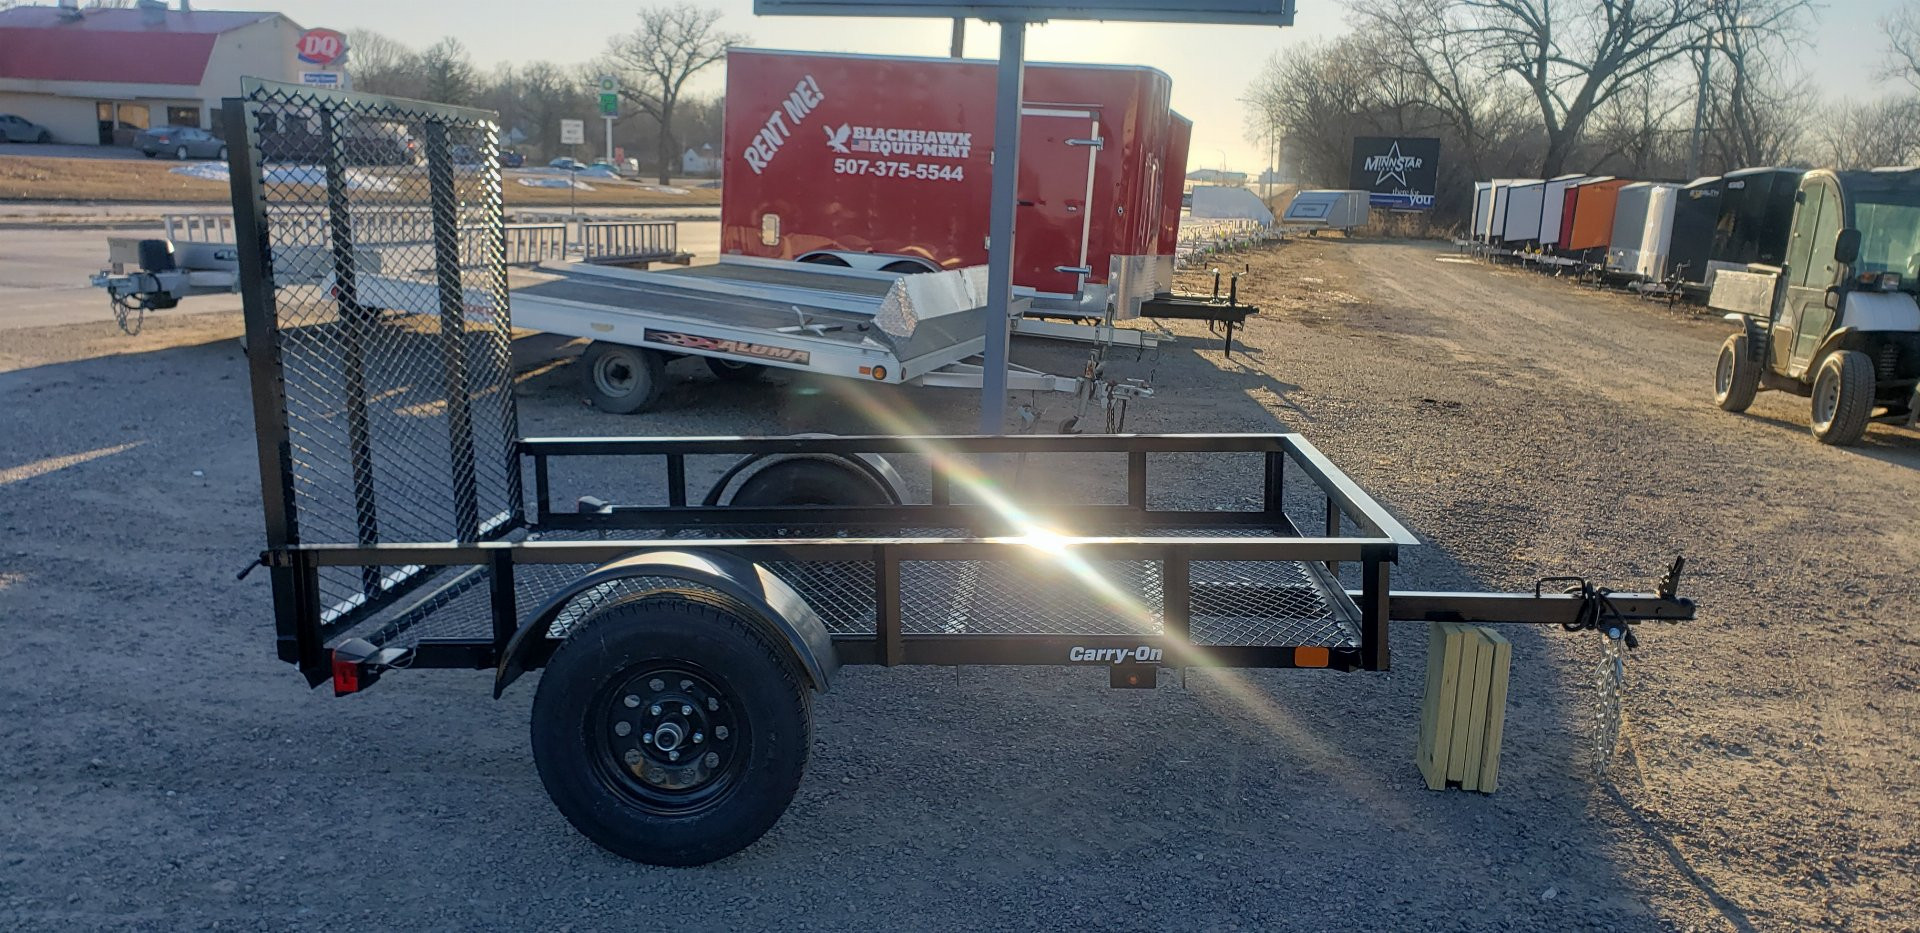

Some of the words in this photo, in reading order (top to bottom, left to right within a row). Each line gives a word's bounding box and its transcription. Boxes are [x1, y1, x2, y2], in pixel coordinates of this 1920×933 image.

[305, 36, 338, 58] DQ
[744, 111, 790, 175] RENT
[783, 74, 825, 125] ME!
[852, 126, 972, 146] BLACKHAWK
[870, 140, 971, 158] EQUIPMENT
[834, 158, 964, 181] 507-375-5544
[1410, 195, 1431, 206] you
[717, 340, 809, 363] ALUMA
[1070, 646, 1163, 664] Carry-On
